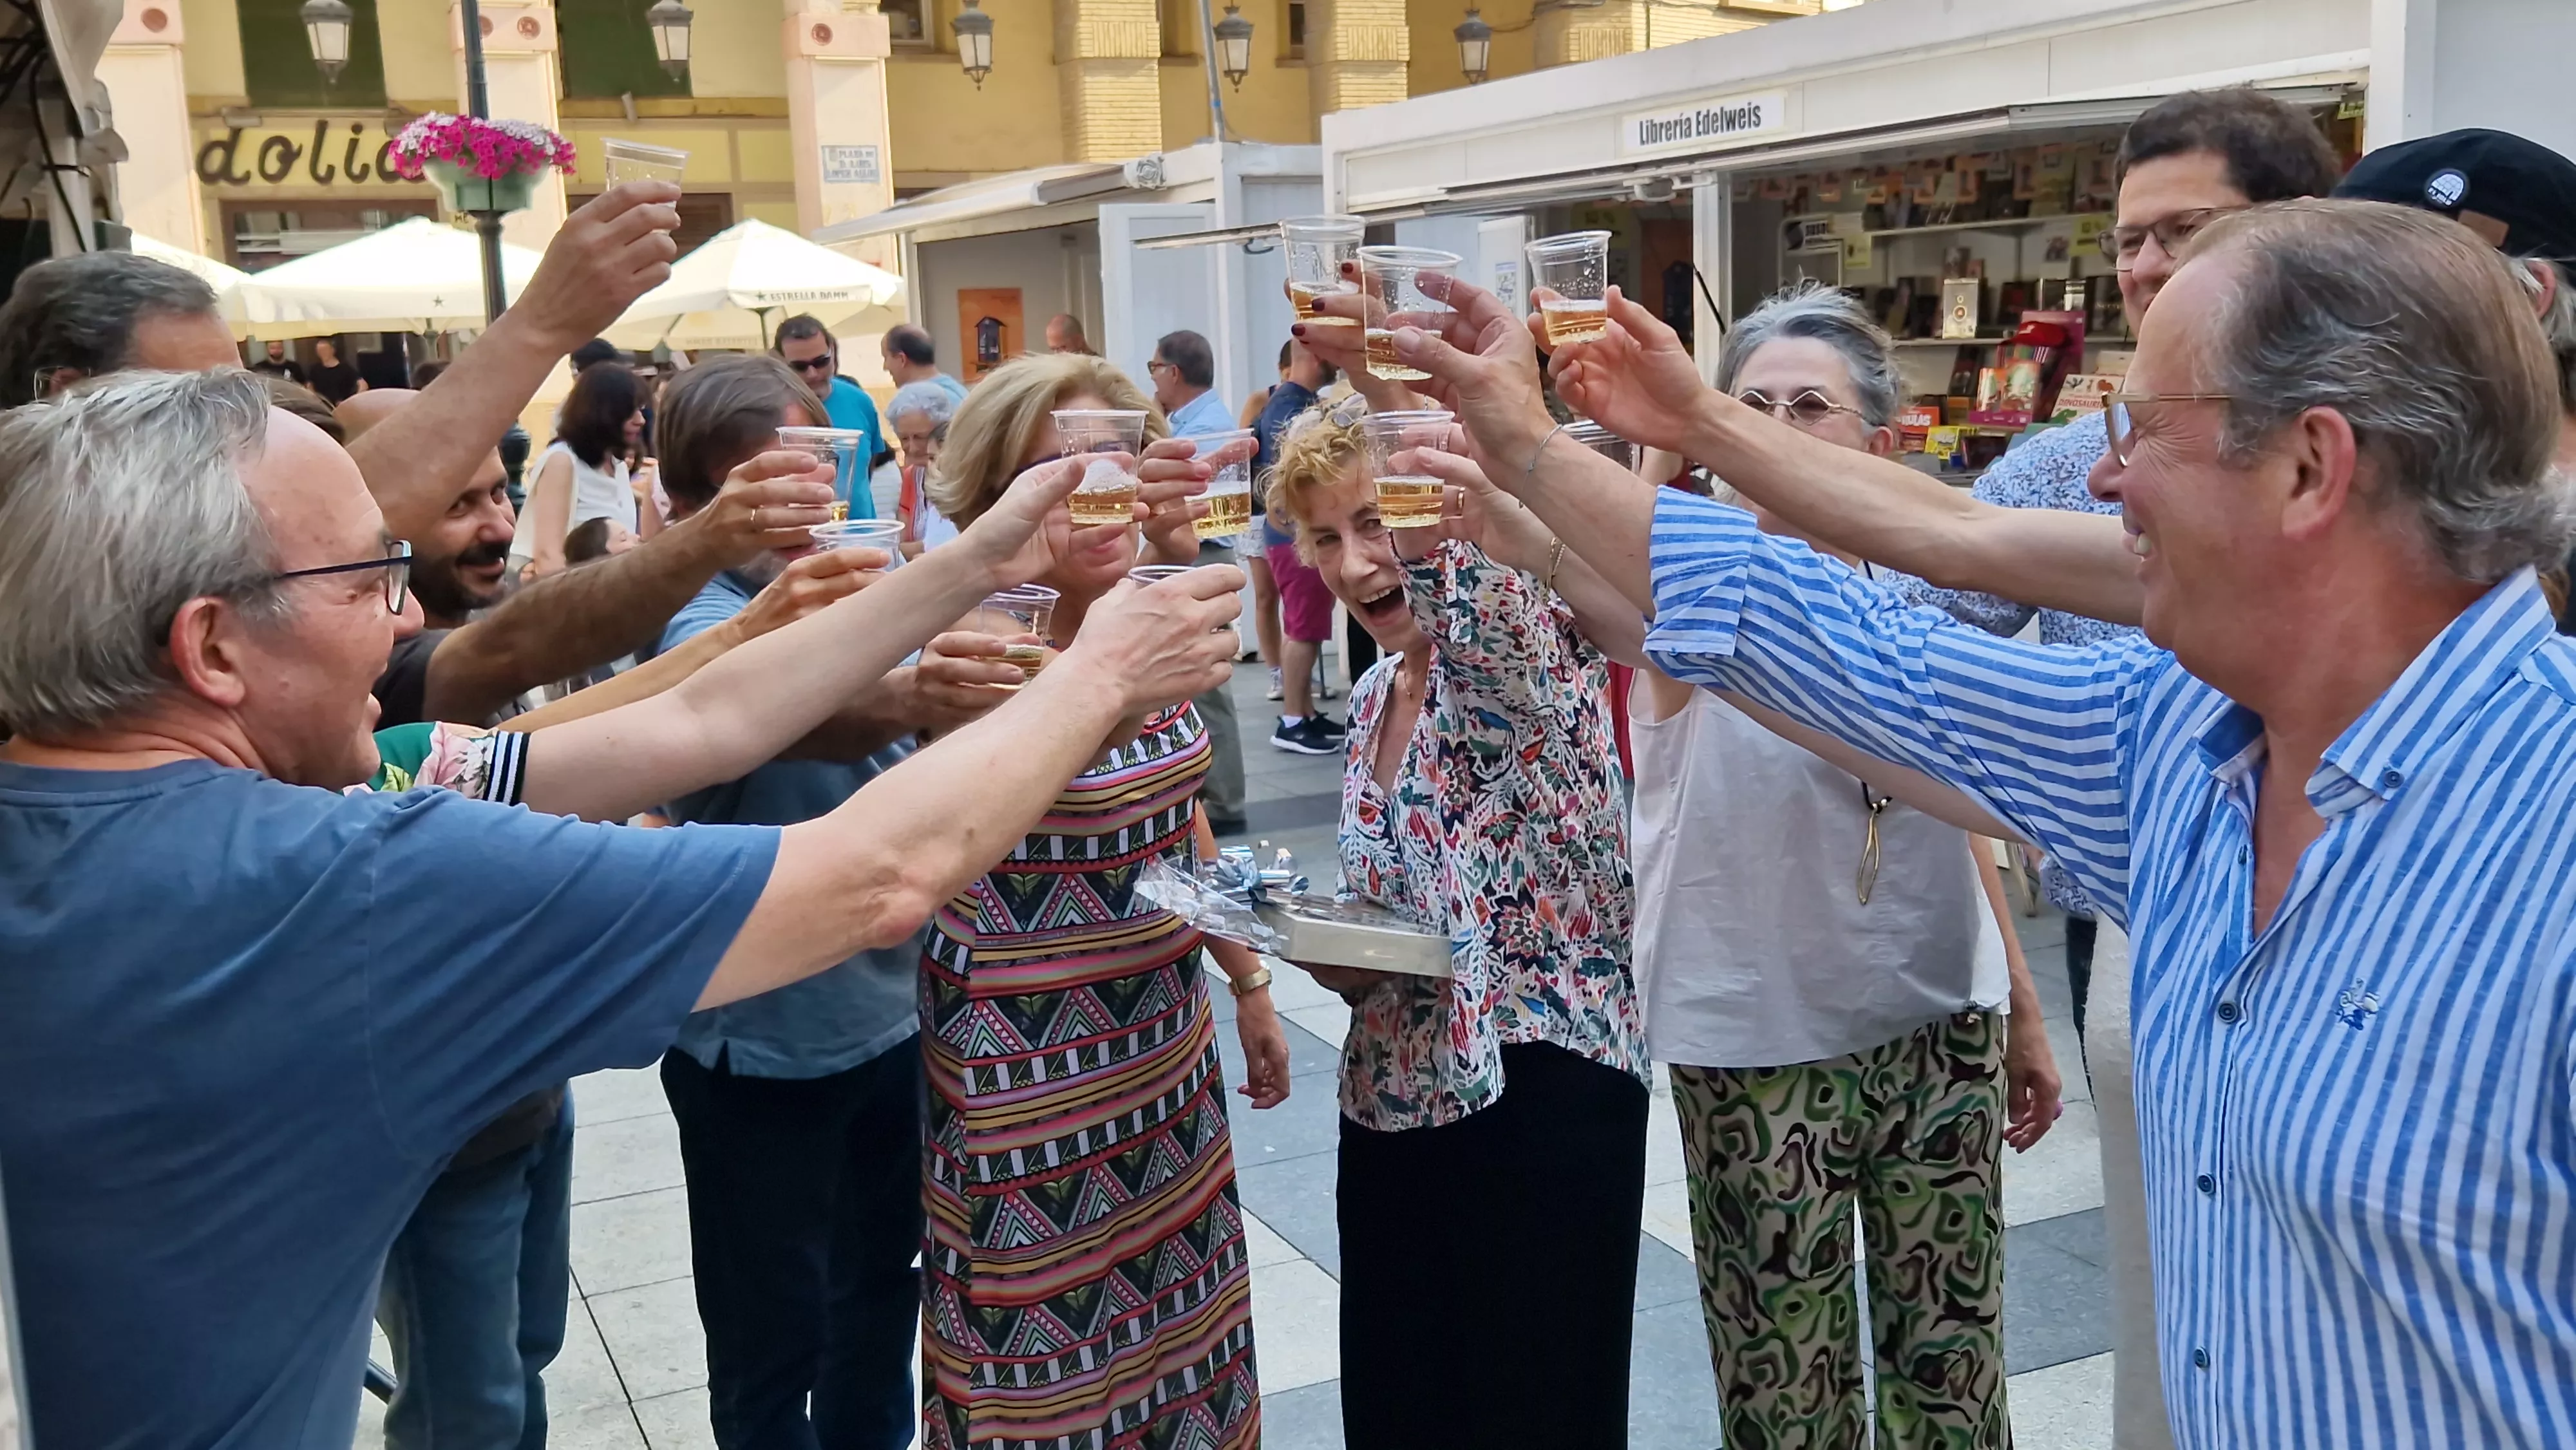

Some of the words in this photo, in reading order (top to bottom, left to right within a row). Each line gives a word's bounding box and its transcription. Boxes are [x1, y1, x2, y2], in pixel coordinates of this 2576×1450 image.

[1639, 112, 1692, 146] Librería
[1696, 101, 1761, 137] Edelweis
[770, 292, 817, 301] ESTRELLA
[820, 291, 849, 300] DAMM
